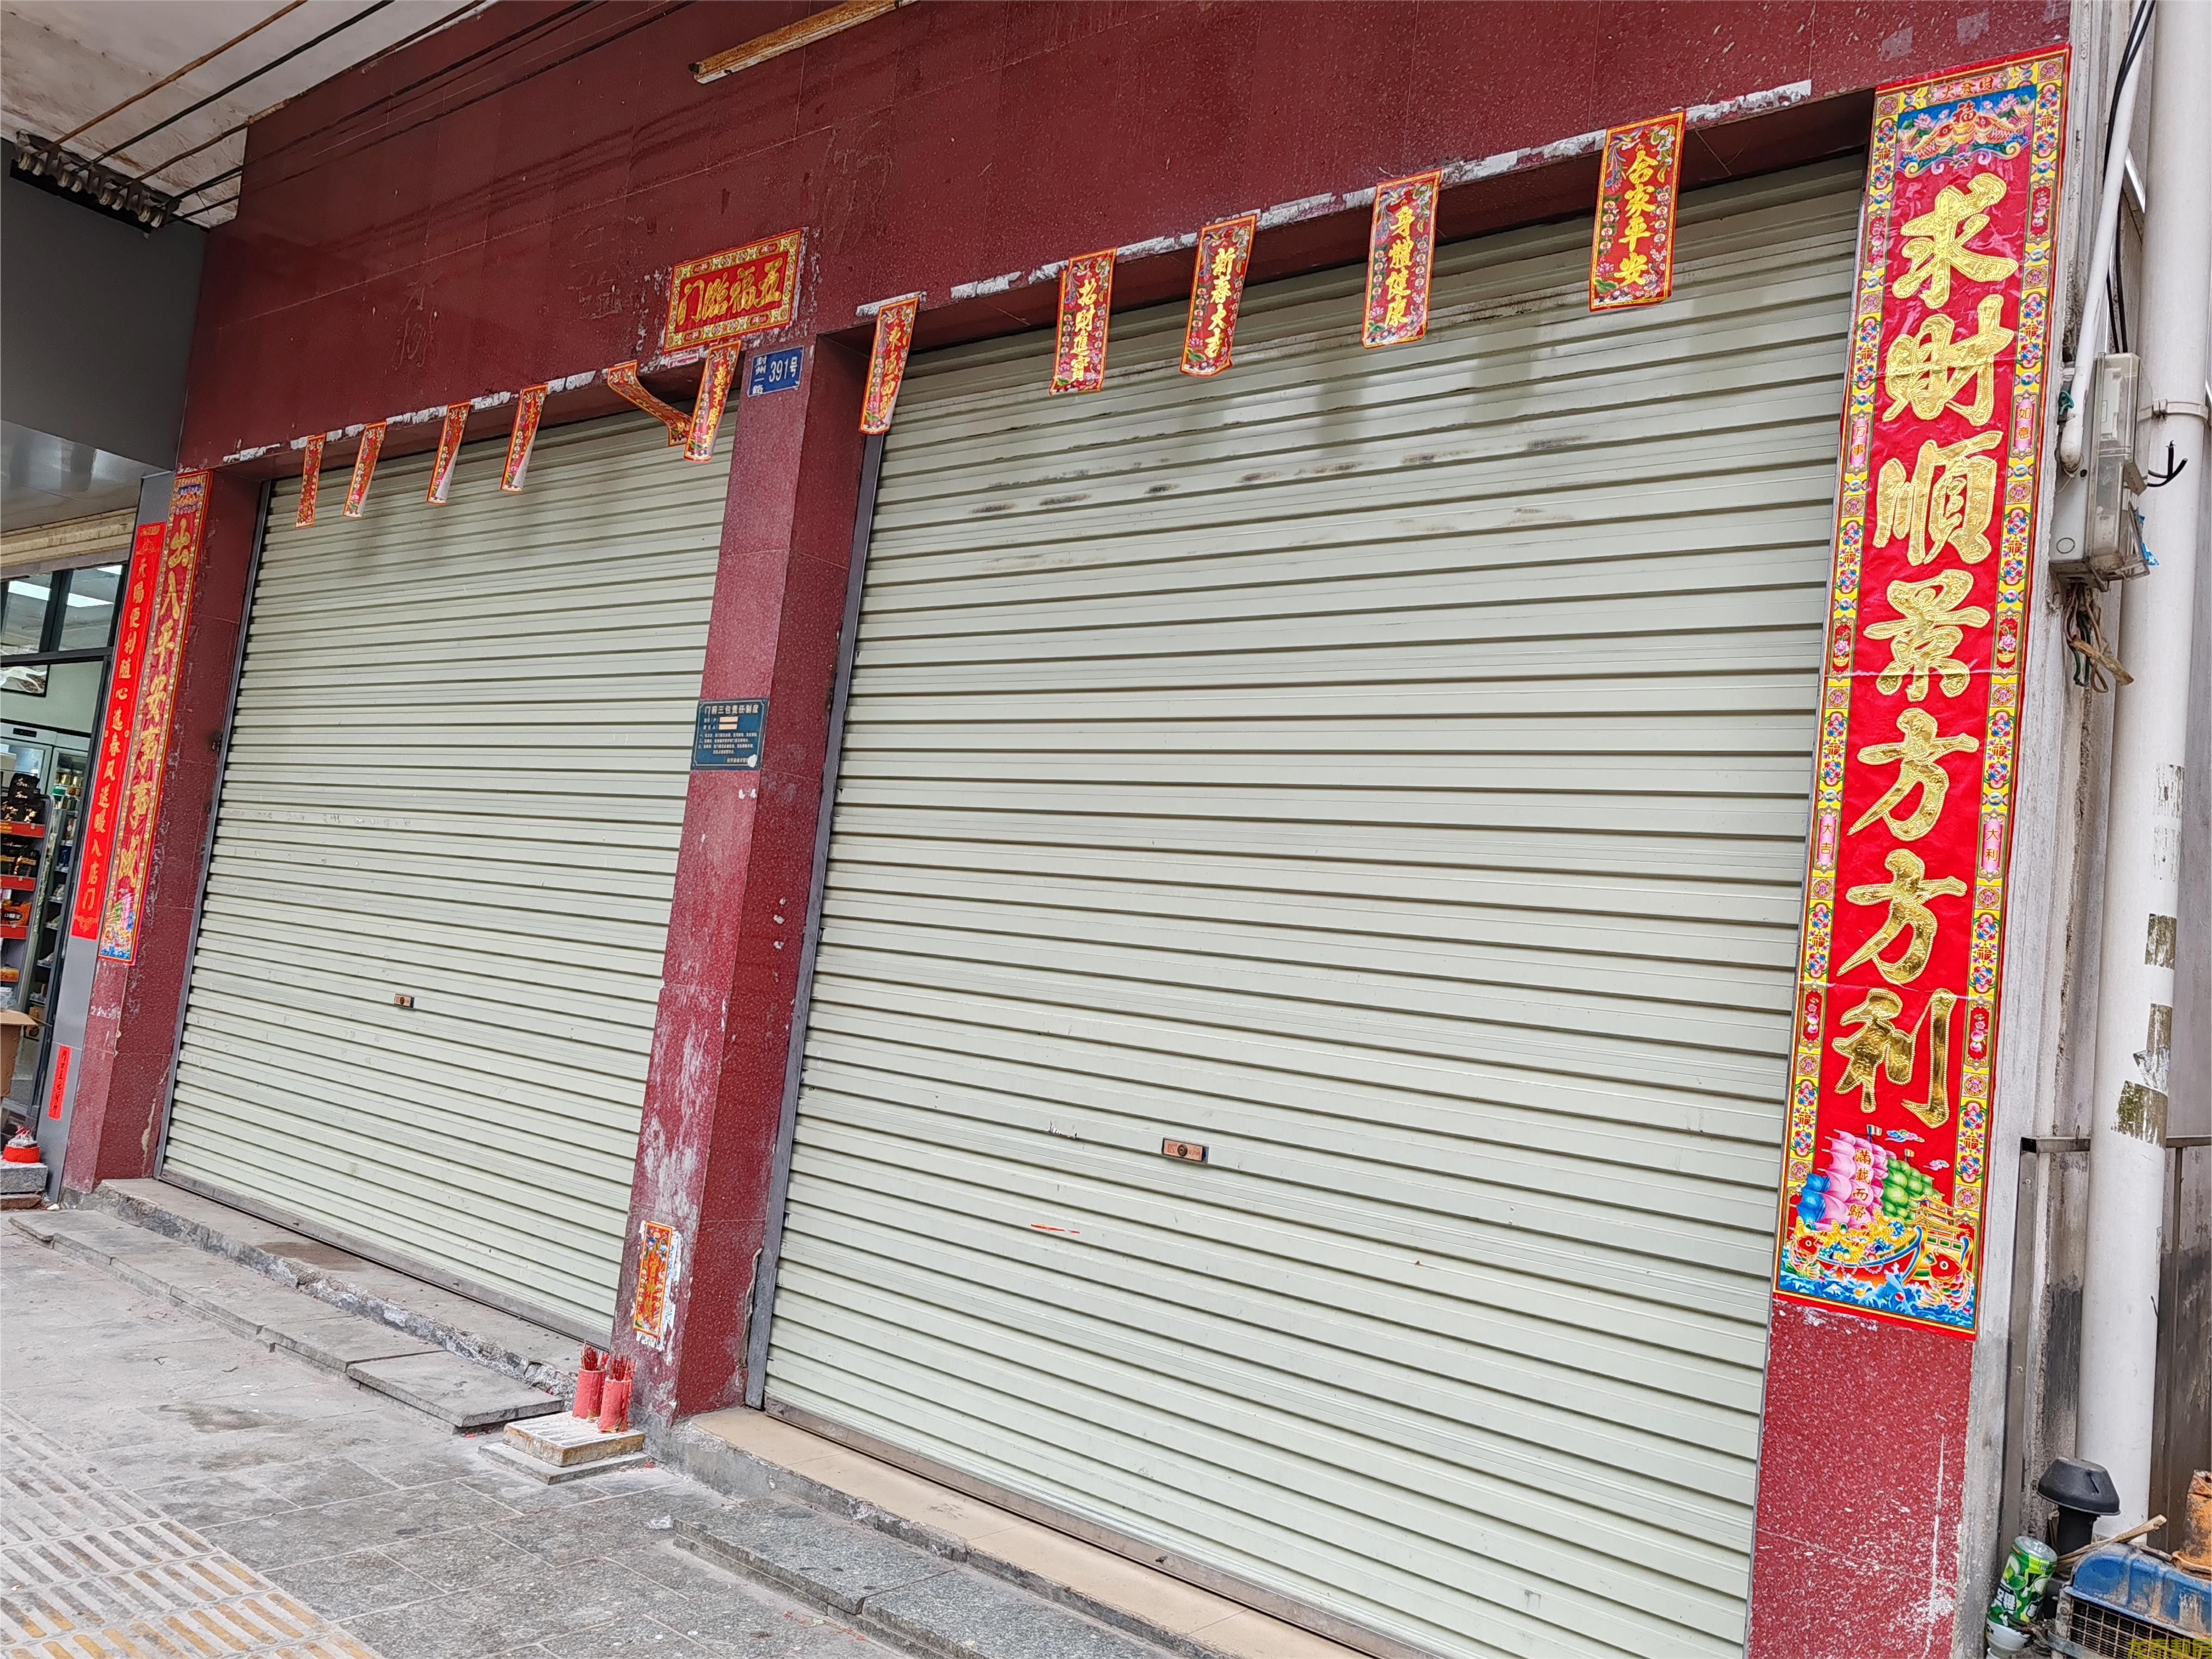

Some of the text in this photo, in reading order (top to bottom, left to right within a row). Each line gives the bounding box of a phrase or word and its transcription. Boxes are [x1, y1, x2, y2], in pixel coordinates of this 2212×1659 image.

[1940, 76, 1994, 101] 大發財
[1953, 101, 1977, 125] 福
[1614, 149, 1658, 287] 合家平安
[1384, 205, 1416, 328] 身體健康
[1204, 247, 1237, 359] 新春大吉
[1070, 277, 1098, 382] 招財進寶
[769, 355, 798, 383] 391号
[1852, 426, 1866, 456] 万事
[2016, 407, 2031, 440] 如意
[1831, 172, 2018, 1128] 求財順景方方利
[1819, 821, 1835, 855] 大吉
[1984, 827, 1999, 863] 大利
[1847, 1148, 1872, 1222] 滿載而歸
